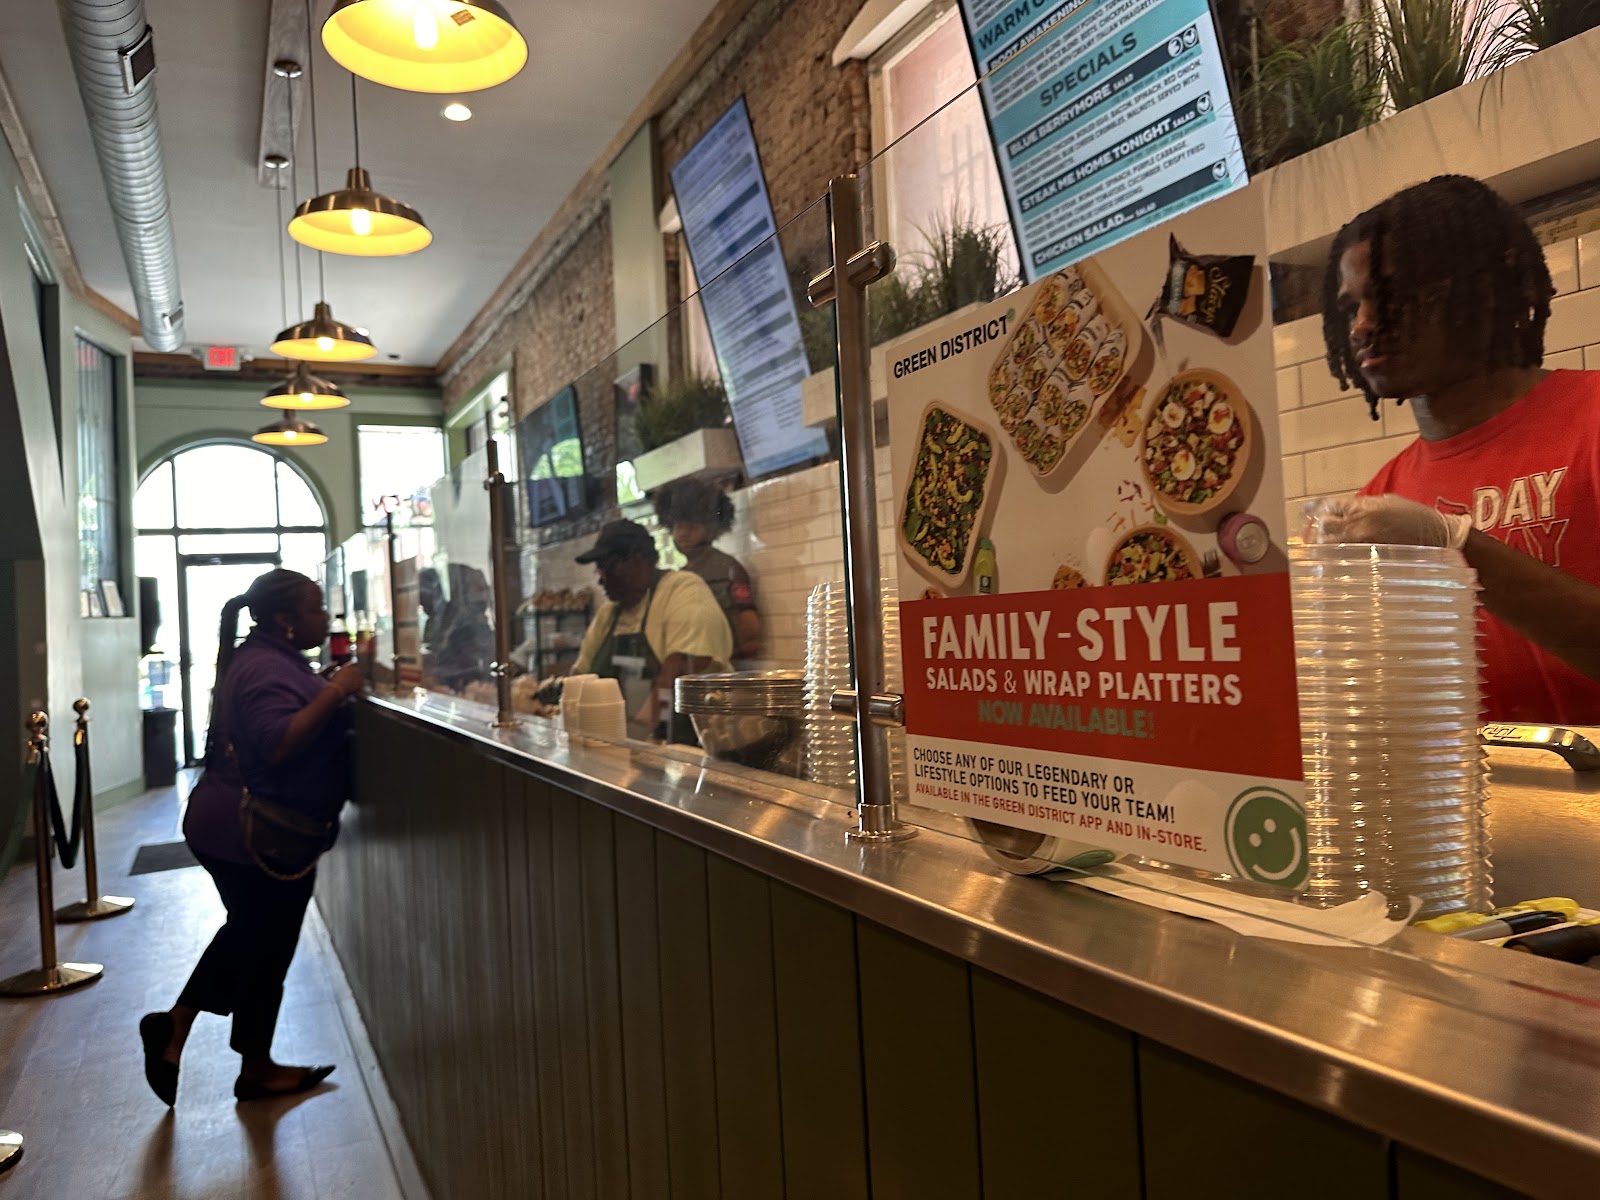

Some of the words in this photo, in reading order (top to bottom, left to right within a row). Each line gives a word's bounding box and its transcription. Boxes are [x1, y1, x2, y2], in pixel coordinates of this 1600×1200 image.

[979, 0, 1029, 52] WARM
[1039, 29, 1137, 108] SPECIALS
[1009, 129, 1039, 156] BLUE
[1038, 83, 1111, 137] BERRYMORE
[1021, 182, 1057, 210] STEAK
[1057, 171, 1076, 190] ME
[1075, 150, 1113, 180] HOME
[1112, 117, 1172, 160] TONIGHT
[1034, 232, 1084, 265] CHICKEN
[894, 346, 937, 378] GREEN
[941, 315, 1007, 360] DISTRICT
[1473, 466, 1568, 533] DAY
[926, 667, 998, 693] SALADS
[1003, 669, 1017, 694] &
[1024, 670, 1091, 697] WRAP
[1099, 671, 1243, 706] PLATTERS
[977, 700, 1022, 726] NOW
[1028, 703, 1154, 739] AVAILABLE!
[913, 747, 952, 765] CHOOSE
[955, 753, 977, 769] ANY
[980, 756, 995, 772] OF
[998, 759, 1023, 777] OUR
[1027, 763, 1108, 791] LEGENDARY
[1113, 775, 1135, 795] OR
[914, 763, 967, 785] LIFESTYLE
[969, 772, 1019, 795] OPTIONS
[1022, 781, 1039, 798] TO
[1043, 784, 1077, 805] FEED
[1081, 791, 1121, 814] YOUR
[1125, 798, 1175, 823] TEAM!
[915, 782, 960, 801] AVAILABLE
[960, 790, 970, 804] IN
[972, 793, 990, 808] THE
[993, 797, 1025, 815] GREEN
[1028, 803, 1075, 825] DISTRICT
[1079, 814, 1102, 831] APP
[1106, 819, 1133, 838] AND
[1137, 825, 1207, 852] IN-STORE.
